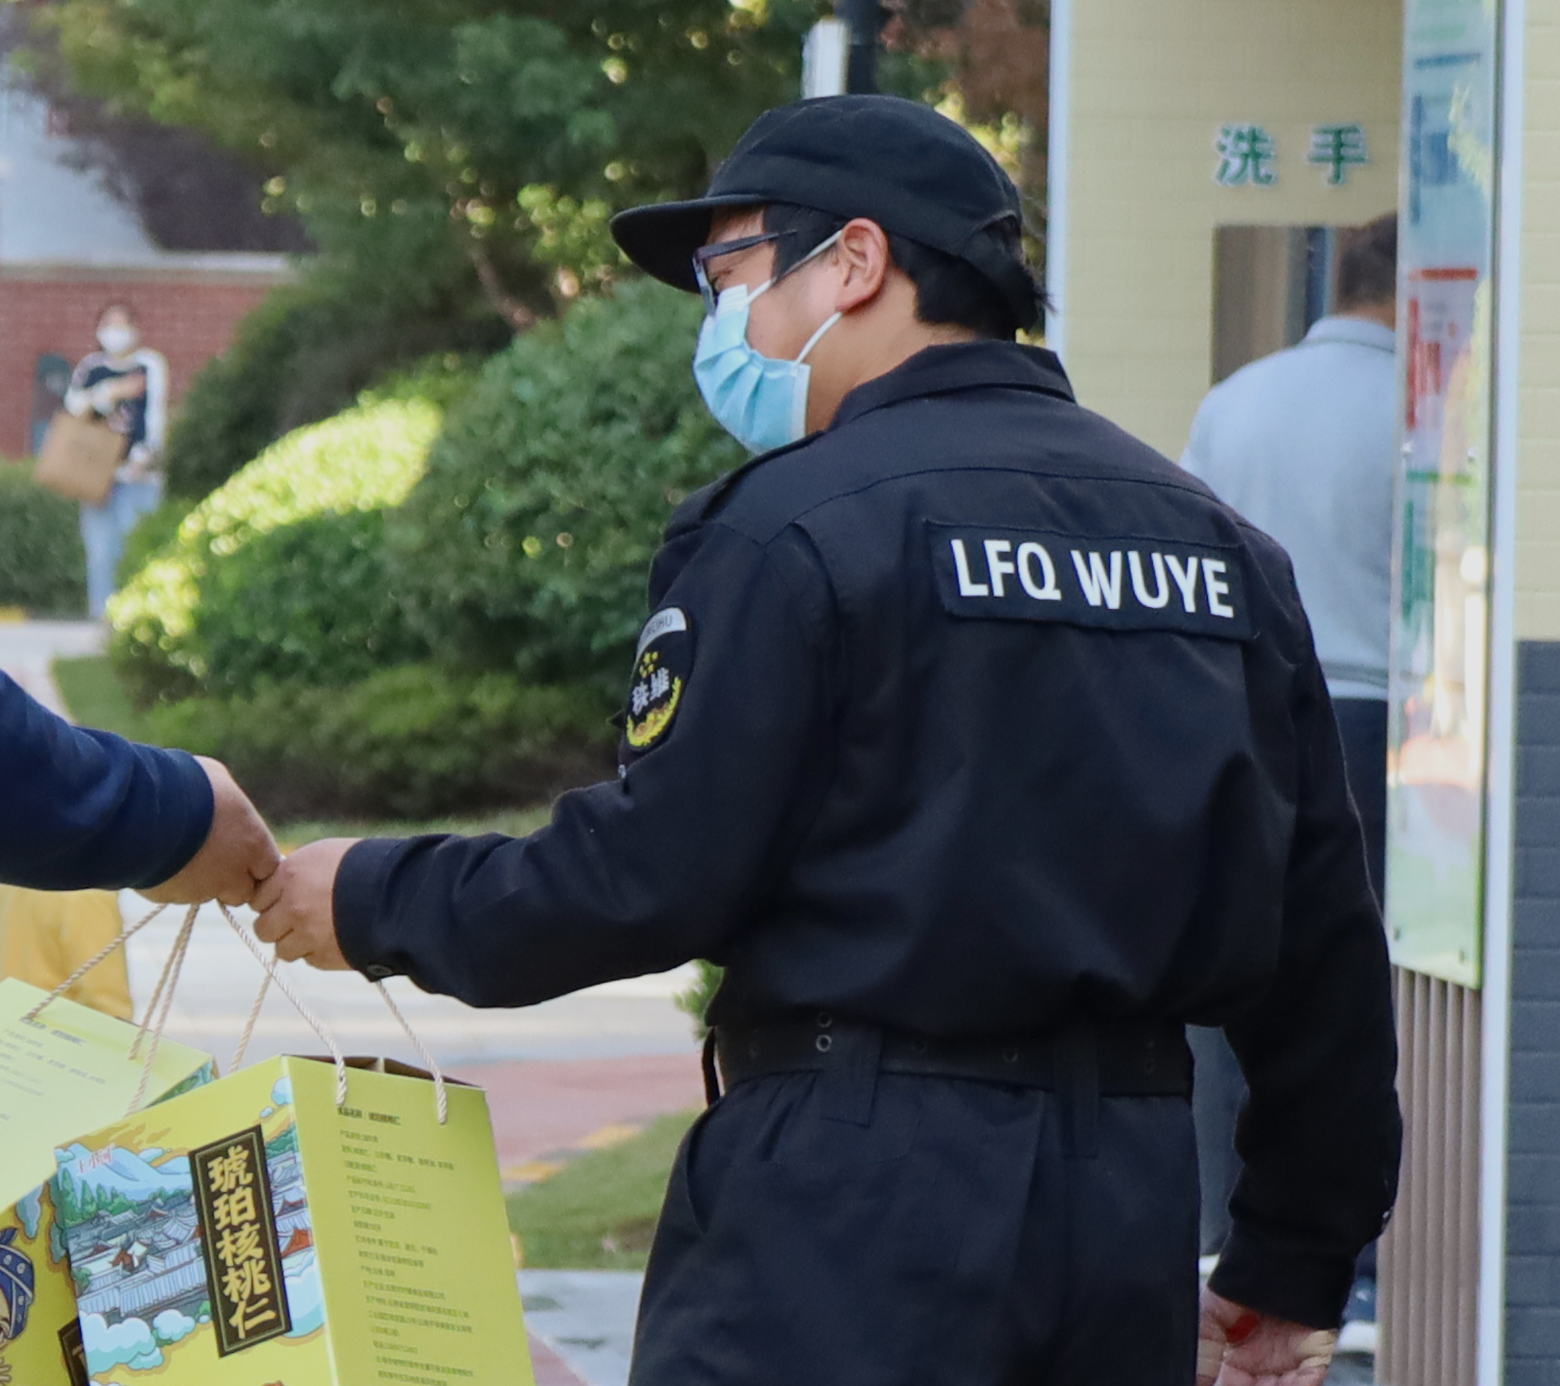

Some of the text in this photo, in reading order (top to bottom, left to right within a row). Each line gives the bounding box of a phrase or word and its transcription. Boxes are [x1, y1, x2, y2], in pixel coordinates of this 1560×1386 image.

[950, 539, 1234, 618] LFQ WUYE
[207, 1144, 276, 1339] 琥珀核桃仁
